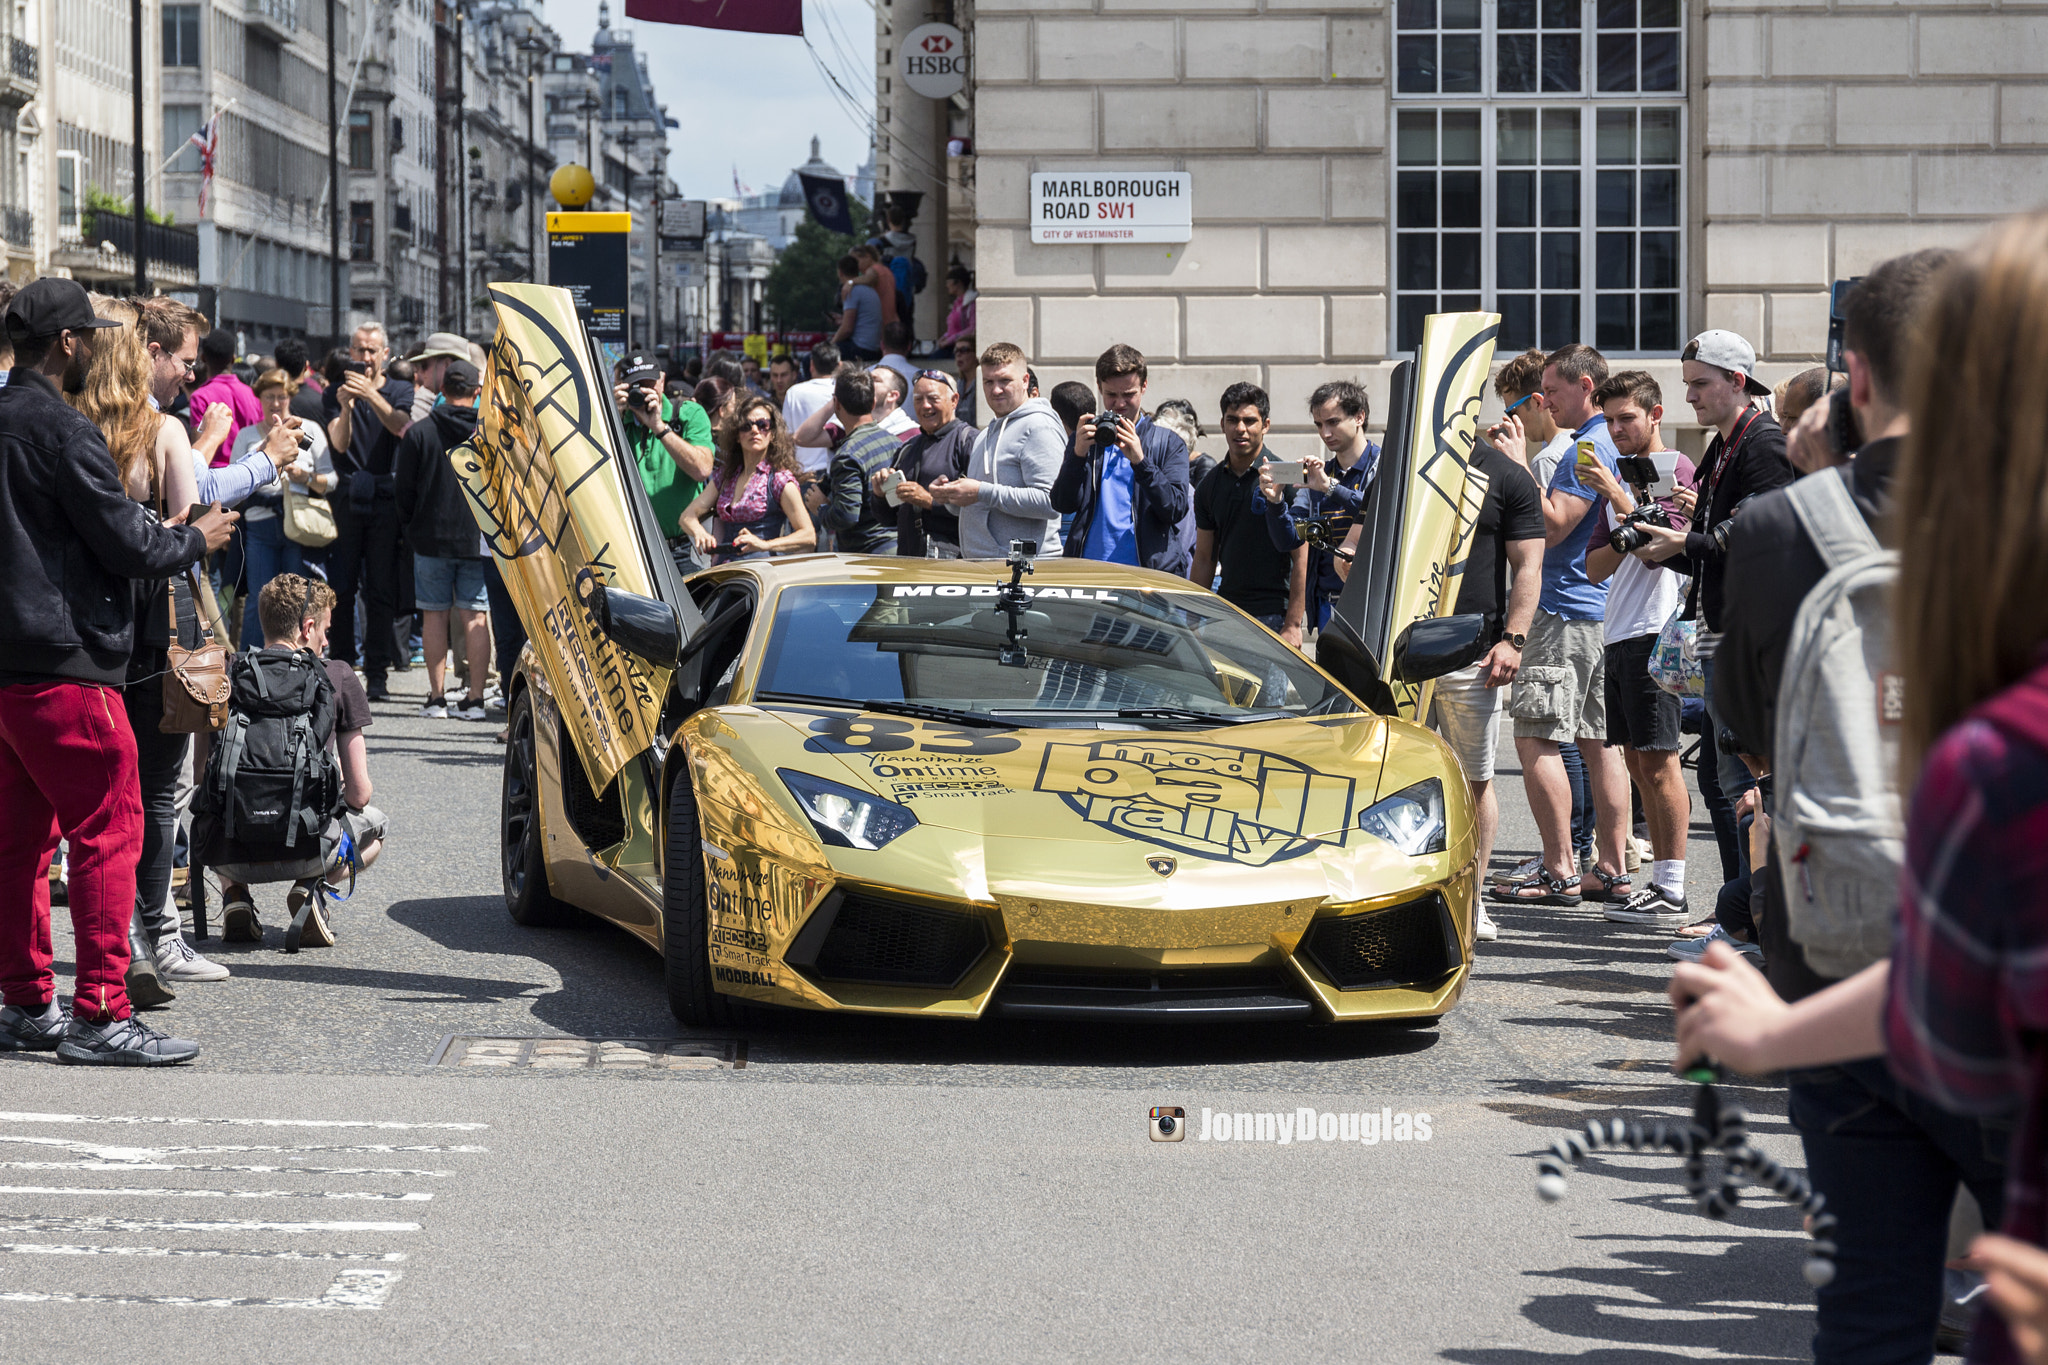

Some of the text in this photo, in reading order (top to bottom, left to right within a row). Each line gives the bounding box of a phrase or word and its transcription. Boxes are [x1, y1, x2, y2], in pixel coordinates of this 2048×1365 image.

[1042, 180, 1180, 198] MARLBOROUGH
[1042, 202, 1135, 219] ROAD SW1
[1043, 230, 1134, 239] CITY OF WESTMINSTER
[803, 717, 1022, 756] 83
[860, 752, 986, 768] Yiannimize
[872, 764, 998, 778] Ontime
[879, 775, 1001, 783] AUTOMOTIVE
[706, 856, 769, 888] Yiannimize
[709, 881, 772, 921] Ontime
[715, 967, 777, 988] MODBALL
